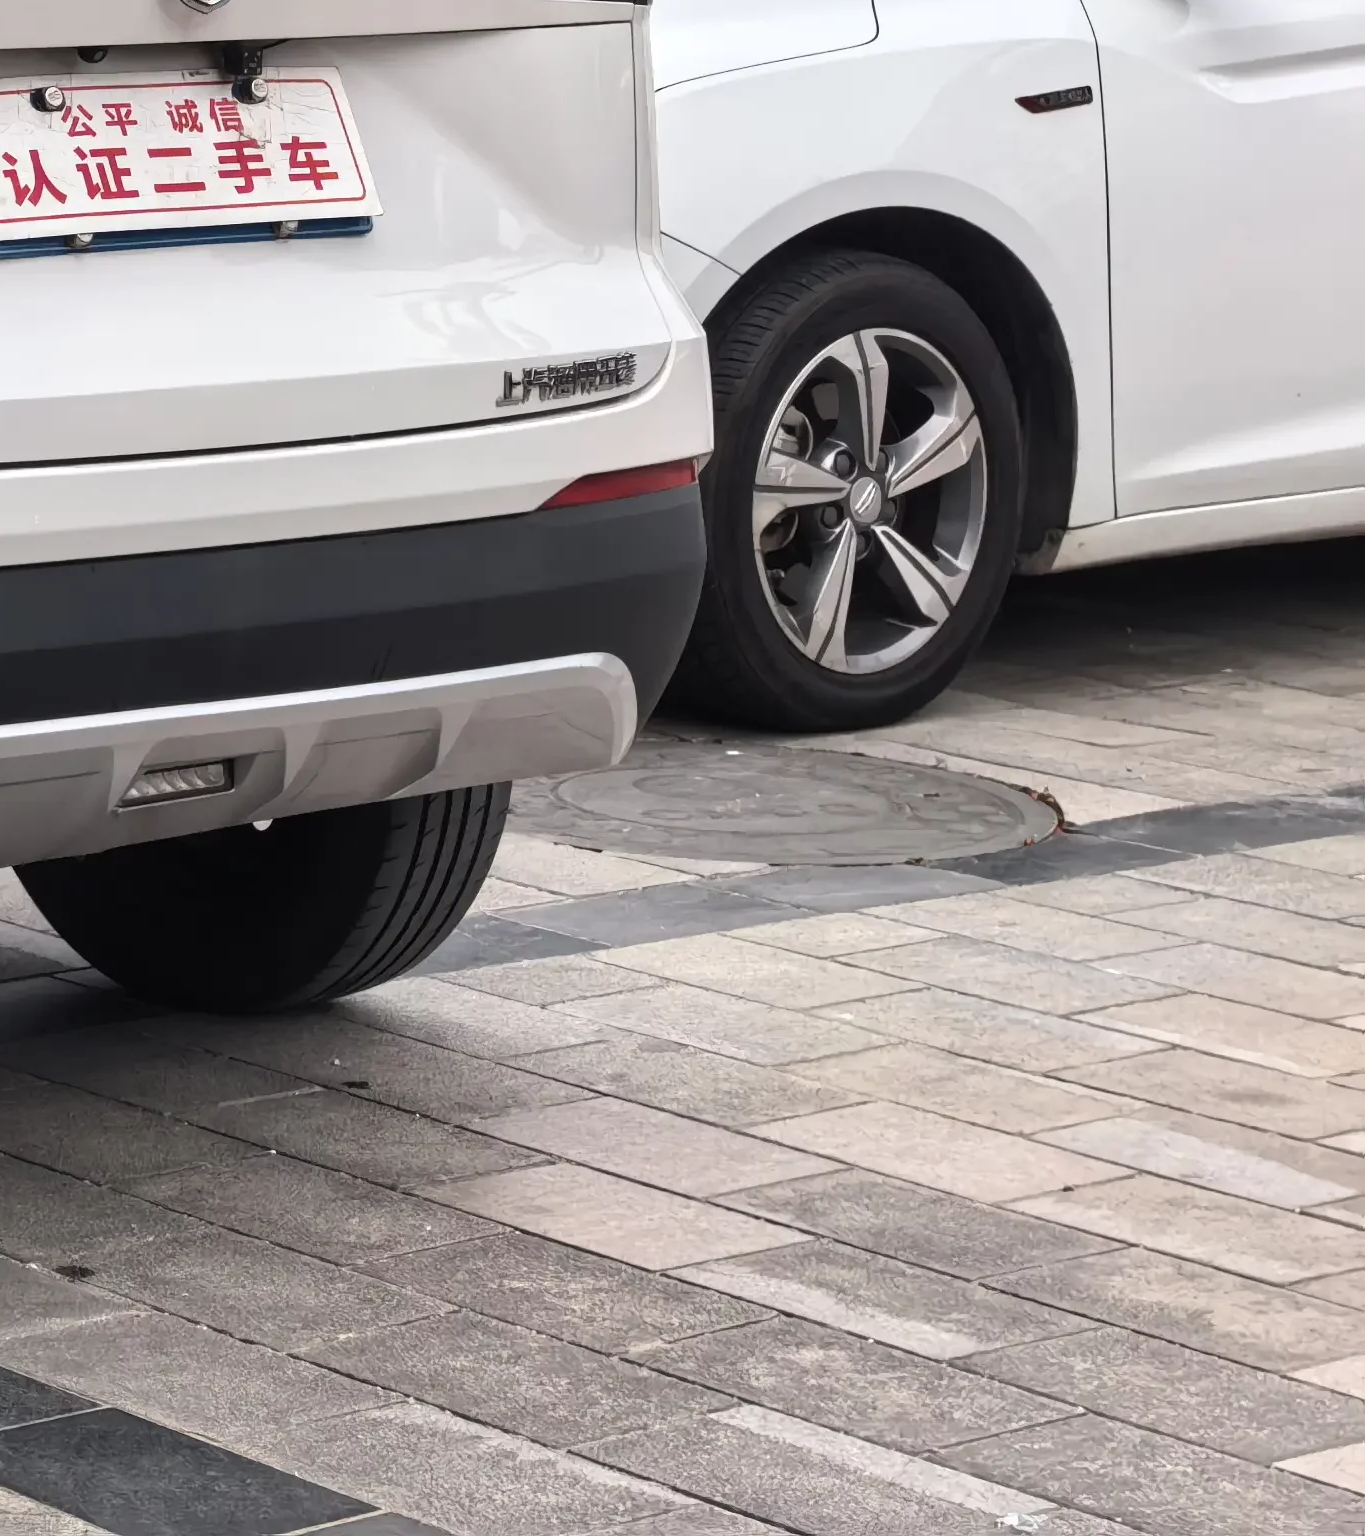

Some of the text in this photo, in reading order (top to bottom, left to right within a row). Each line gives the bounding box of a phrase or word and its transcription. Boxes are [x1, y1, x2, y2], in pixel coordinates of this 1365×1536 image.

[61, 97, 245, 138] 公平 诚信
[3, 136, 340, 209] 认证二手车
